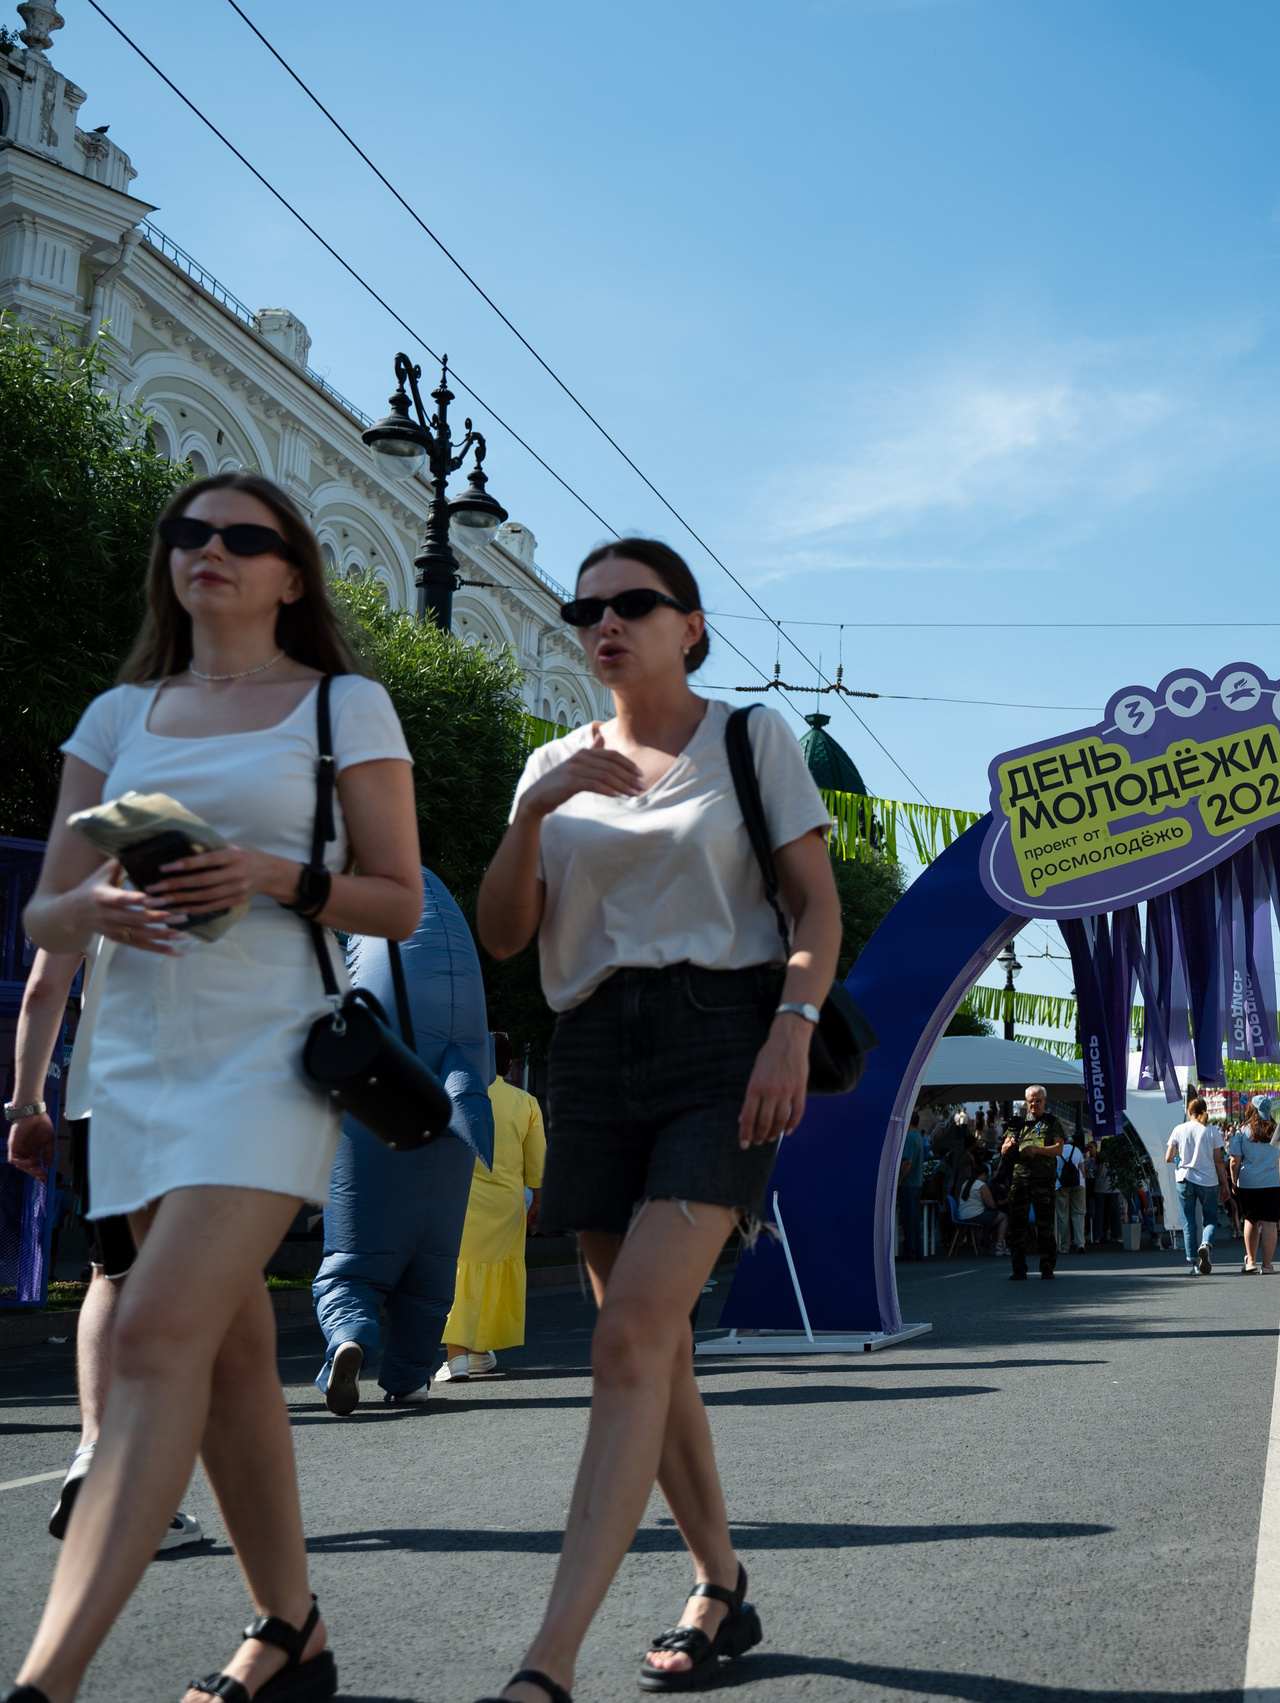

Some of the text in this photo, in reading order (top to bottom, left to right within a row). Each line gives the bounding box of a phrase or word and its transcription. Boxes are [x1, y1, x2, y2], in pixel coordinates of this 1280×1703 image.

[1007, 745, 1122, 808] ДЕНЬ
[1019, 733, 1278, 839] МОЛОДЁЖИ
[1024, 829, 1101, 860] проект от
[1030, 827, 1184, 888] росмолодёжь
[1089, 1034, 1107, 1125] ГОРДИСЬ
